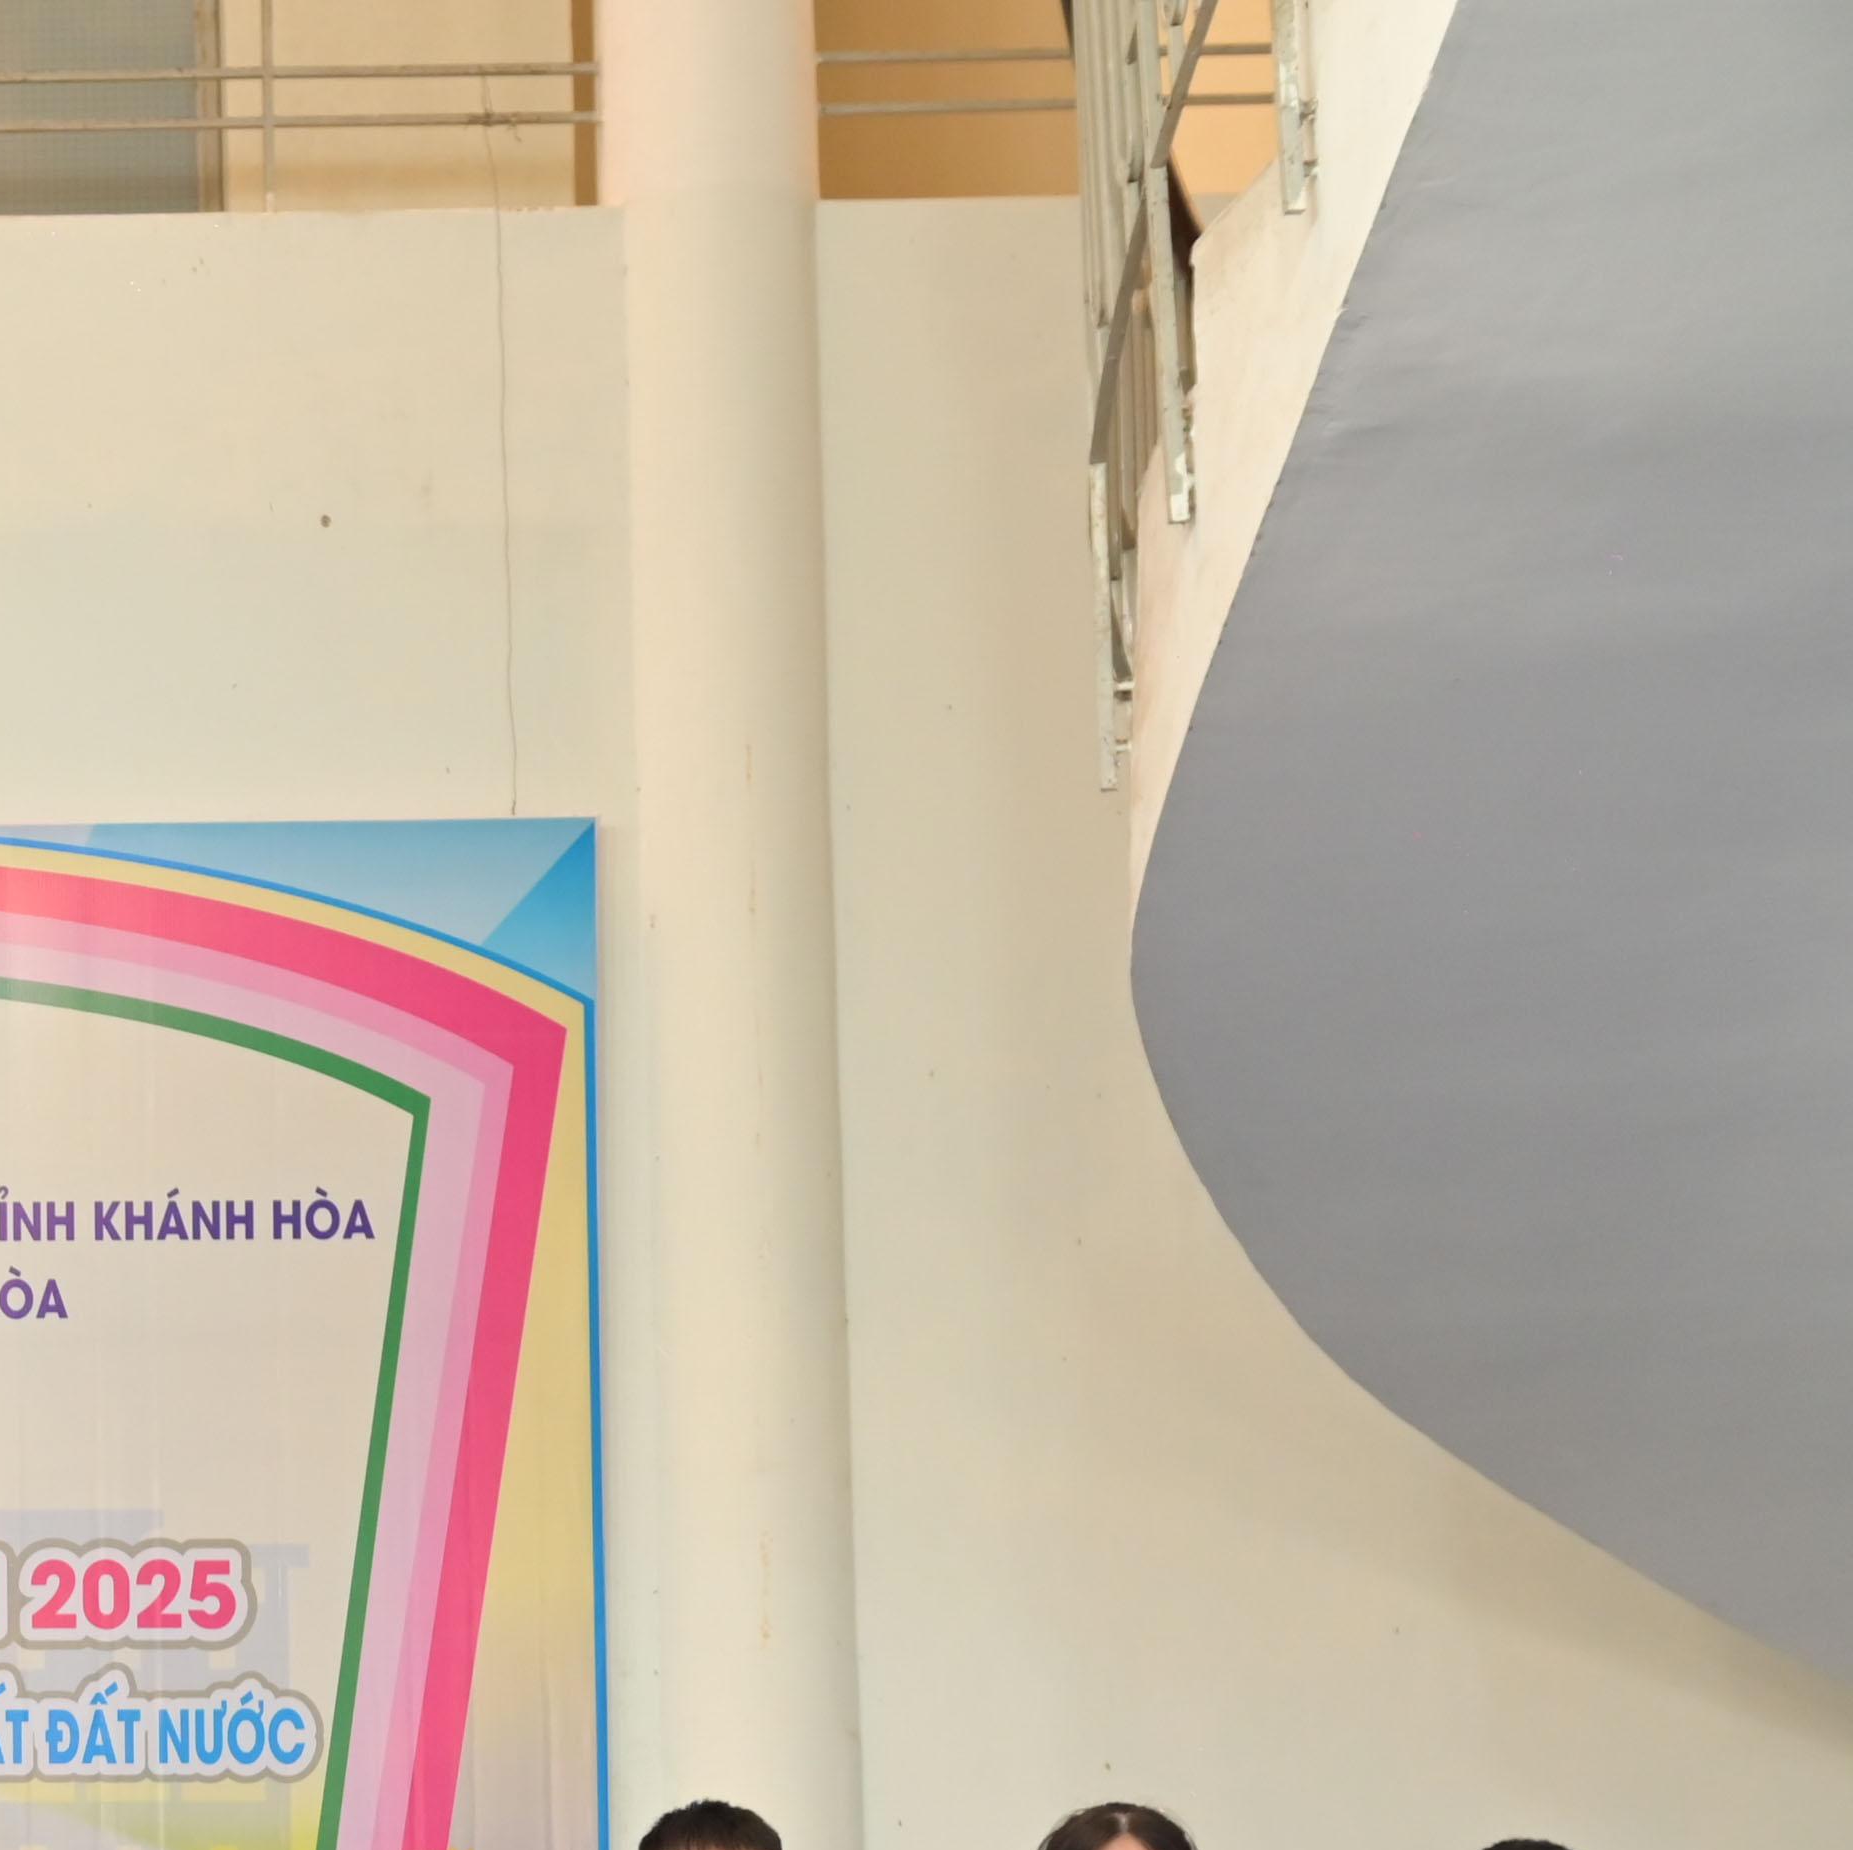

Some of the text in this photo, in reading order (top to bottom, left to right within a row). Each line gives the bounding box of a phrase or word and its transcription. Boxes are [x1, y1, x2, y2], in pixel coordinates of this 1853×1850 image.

[95, 1189, 254, 1240] KHÁNH
[272, 1188, 375, 1240] HÒA
[30, 1559, 237, 1632] 2025
[45, 1681, 141, 1765] ĐẤT
[157, 1684, 307, 1764] NƯỚC
